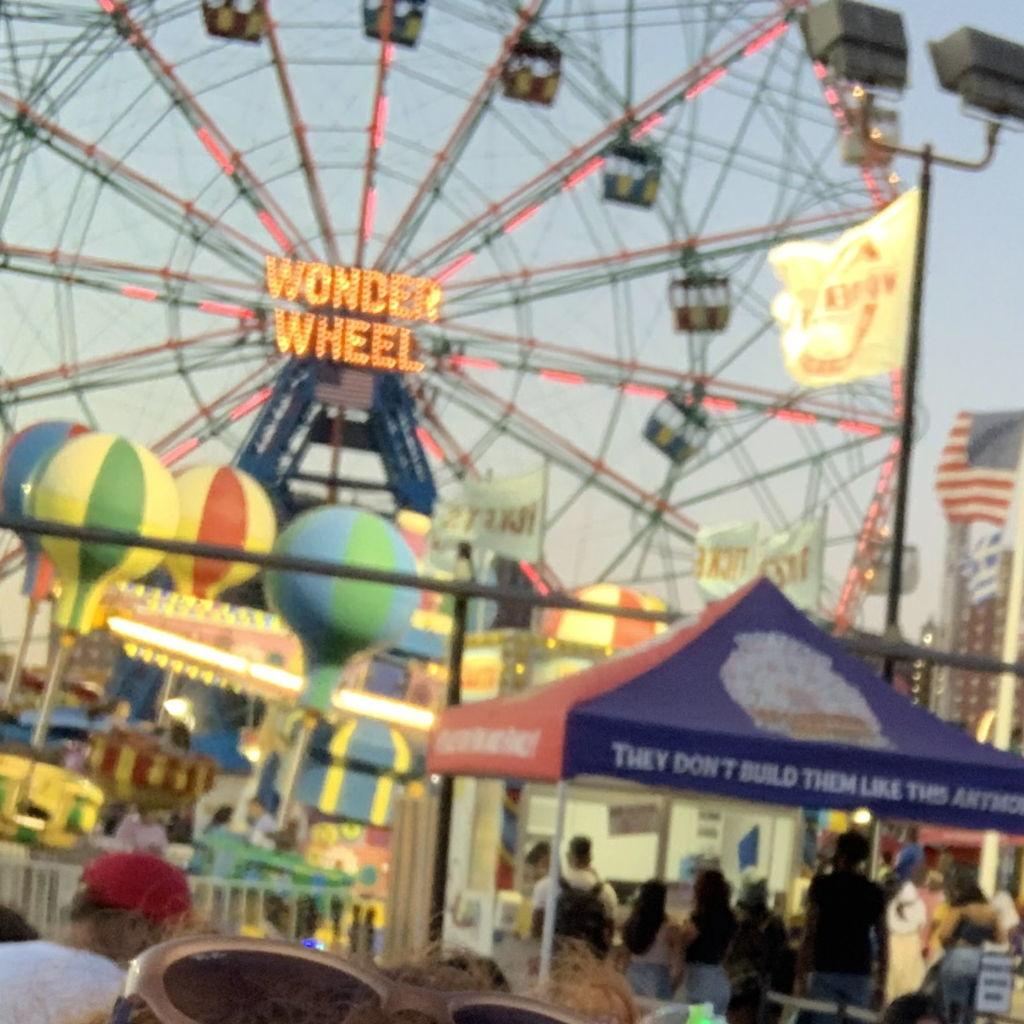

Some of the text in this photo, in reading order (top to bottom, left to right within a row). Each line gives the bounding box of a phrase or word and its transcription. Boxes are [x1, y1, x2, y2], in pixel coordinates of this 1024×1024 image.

[265, 255, 442, 322] WONDER
[274, 308, 425, 373] WHEEL
[612, 742, 669, 772] THEY
[673, 751, 739, 780] DON'T
[739, 760, 799, 788] BUILD
[801, 768, 858, 795] THEM
[860, 774, 903, 801] LIKE
[906, 780, 950, 806] THIS
